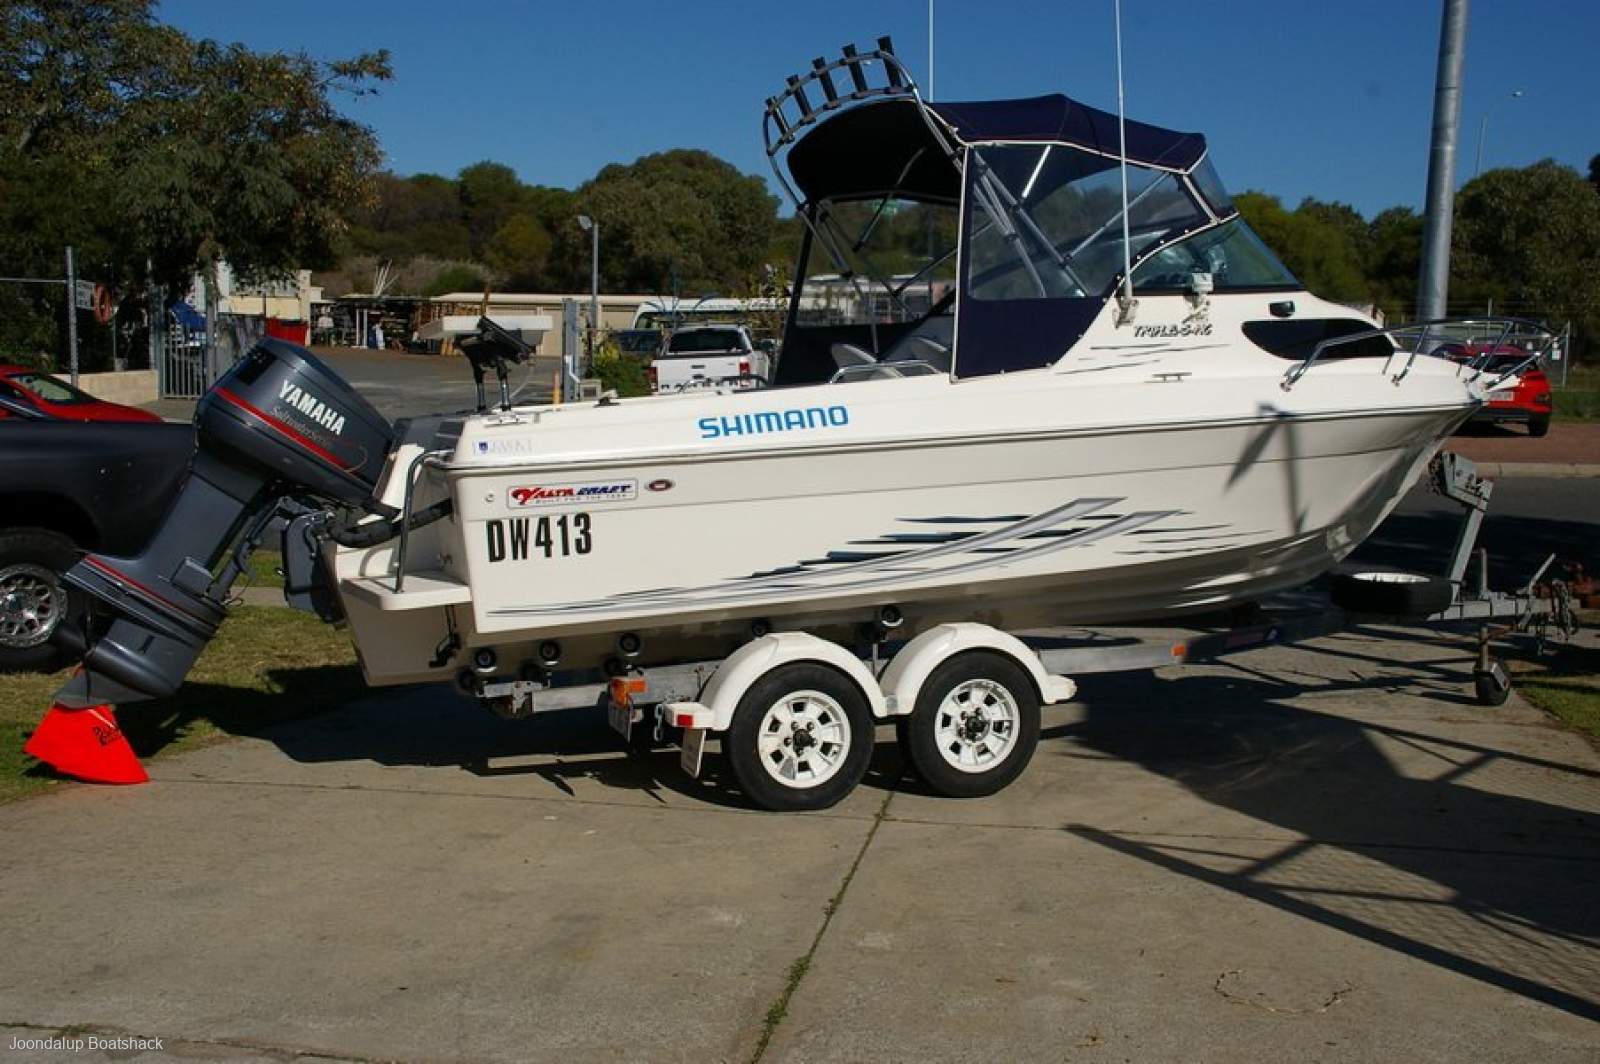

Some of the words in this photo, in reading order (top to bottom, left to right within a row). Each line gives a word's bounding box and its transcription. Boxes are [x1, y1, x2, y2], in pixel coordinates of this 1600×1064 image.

[279, 379, 345, 435] YAMAHA
[699, 405, 849, 438] SHIMANO
[486, 511, 592, 563] DW413
